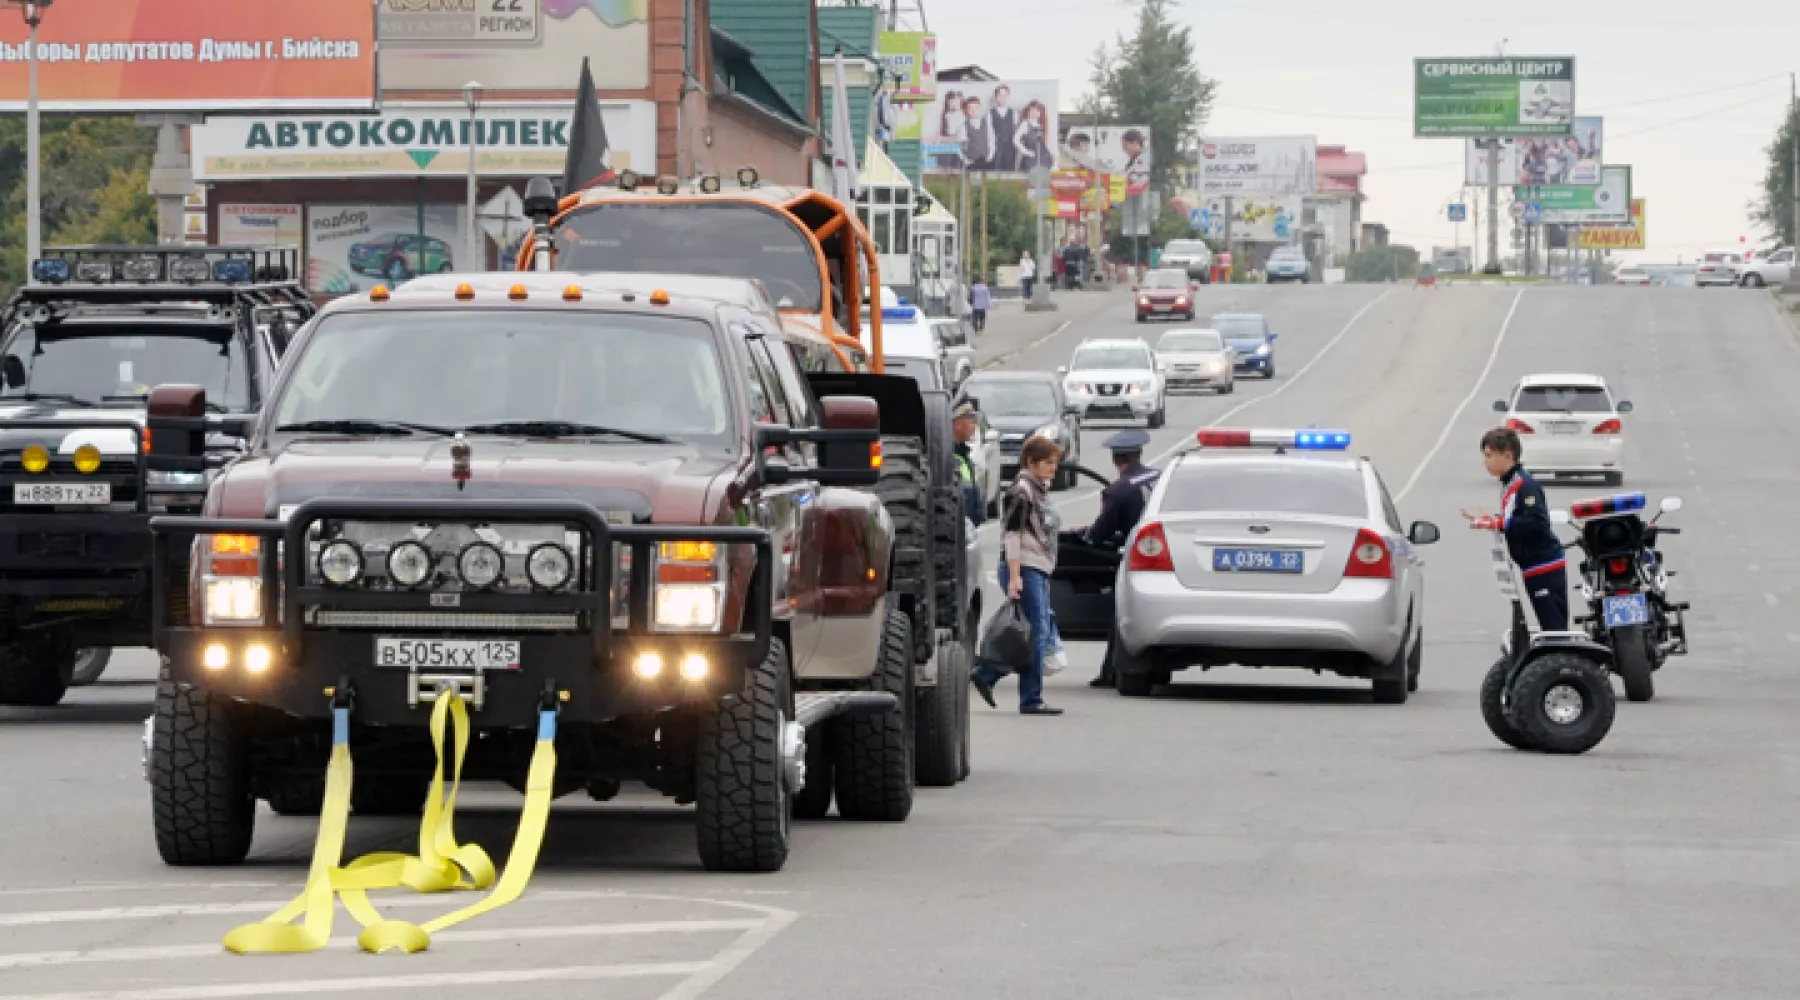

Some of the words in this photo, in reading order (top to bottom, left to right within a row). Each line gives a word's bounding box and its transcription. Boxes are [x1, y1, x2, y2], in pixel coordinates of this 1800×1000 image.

[479, 16, 533, 32] РЕГИОН
[85, 41, 196, 62] депутатов
[198, 38, 261, 63] Думы
[282, 37, 361, 60] Бийска
[1422, 59, 1513, 77] СЕРВИСНЫЙ
[1515, 60, 1564, 77] ЦЕНТР
[312, 208, 369, 230] подбор
[382, 640, 476, 665] В505КХ
[481, 642, 516, 662] 125
